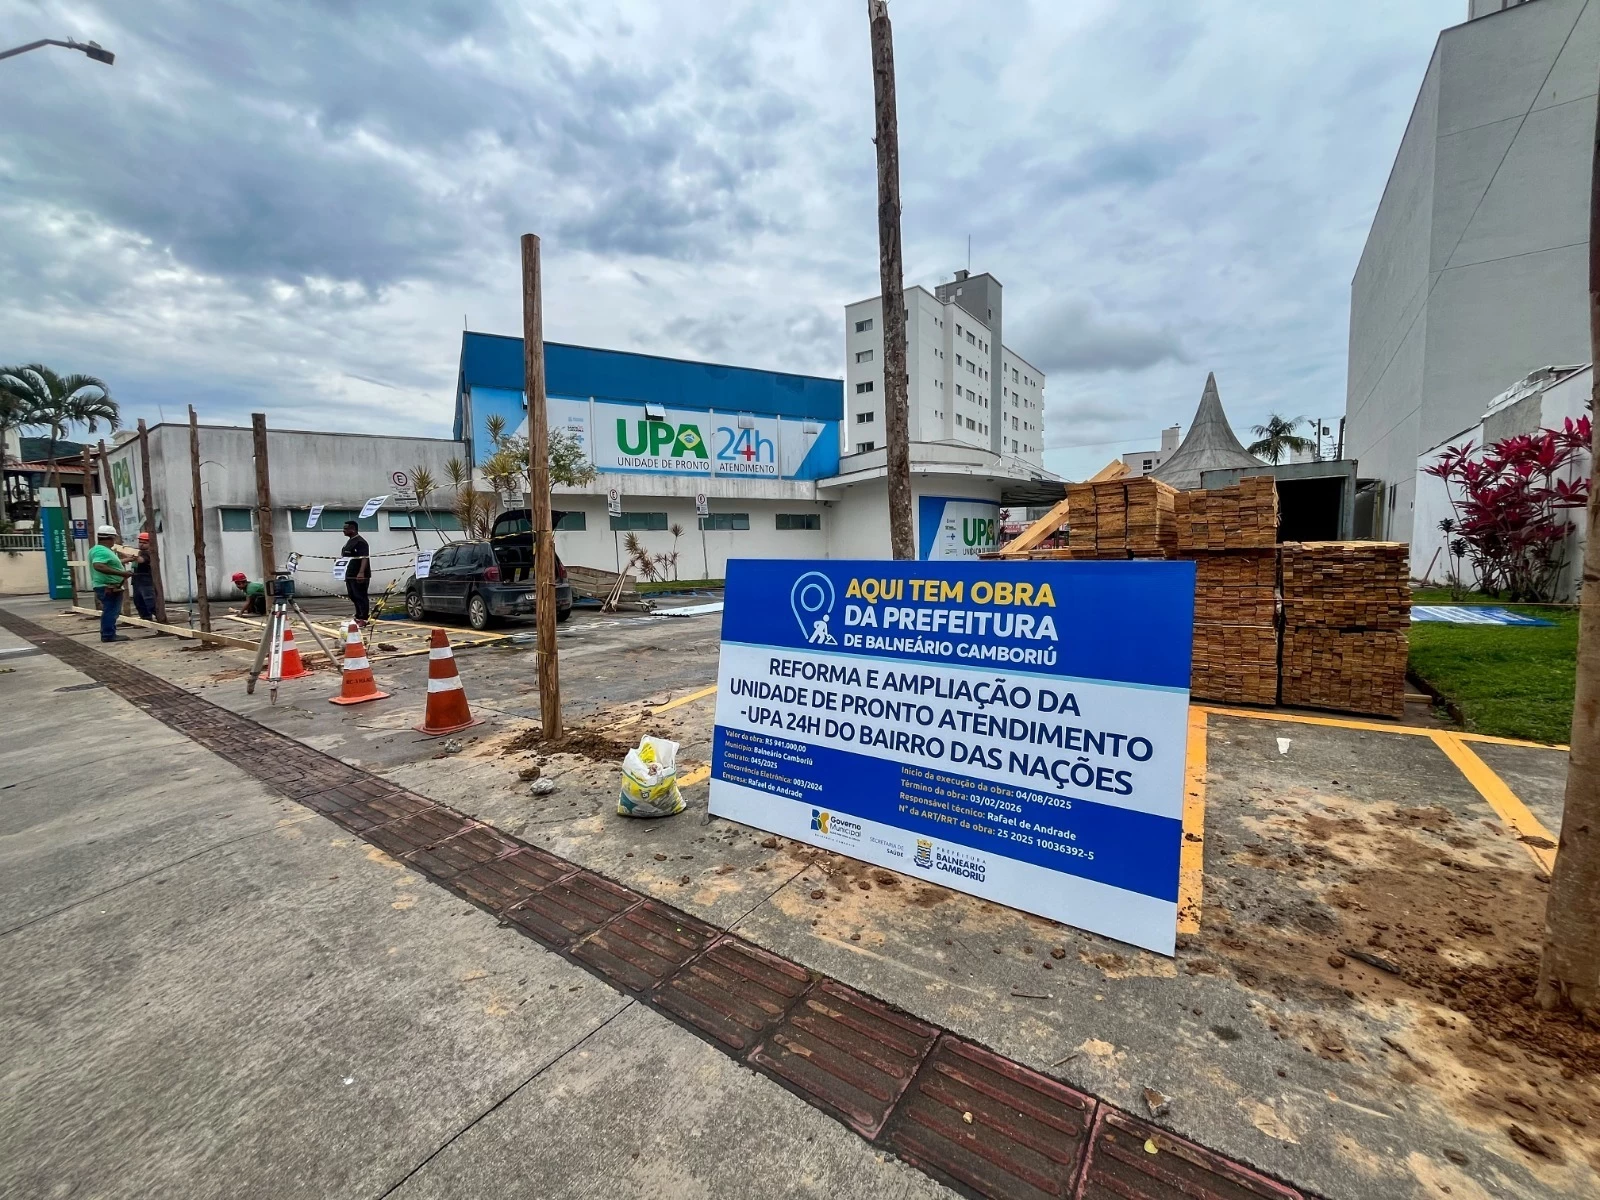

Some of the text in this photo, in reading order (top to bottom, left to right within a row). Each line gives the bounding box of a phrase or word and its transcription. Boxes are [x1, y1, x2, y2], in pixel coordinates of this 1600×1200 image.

[616, 418, 774, 463] UPA 24h
[618, 457, 774, 474] UNIDADE DE PRONTO ATENDIMENTO
[963, 518, 995, 546] UPA
[845, 578, 1056, 607] AQUI TEM OBRA
[844, 604, 1059, 641] DA PREFEITURA
[844, 634, 1057, 666] DE BALNEÁRIO CAMBORIÚ
[770, 658, 1081, 716] REFORMA E AMPLIAÇÃO DA
[730, 678, 1153, 761] UNIDADE DE PRONTO ATENDIMENTO
[724, 751, 778, 768] Contrato: 045/2025
[740, 705, 1133, 795] -UPA 24H DO BAIRRO DAS NAÇÕES
[754, 746, 782, 758] Balneário
[783, 753, 813, 766] Camboriú
[774, 740, 806, 753] 941.000,00
[722, 772, 748, 784] Empresa:
[748, 778, 766, 789] Rafael
[776, 786, 802, 798] Andrade
[723, 761, 823, 791] Concorrência Eletrônica: 003/2024
[901, 779, 1022, 812] Término da obra: 03/02/2026
[924, 771, 934, 780] da
[936, 775, 975, 788] execução
[977, 782, 988, 791] da
[990, 786, 1014, 797] obra:
[1016, 790, 1072, 810] 04/08/2025
[830, 816, 861, 830] Governo
[830, 823, 861, 837] Municipal
[900, 792, 1076, 840] Responsável técnico: Rafael de Andrade
[869, 836, 897, 850] SECRETARIA
[910, 807, 919, 815] da
[921, 810, 958, 825] ART/RRT
[960, 820, 970, 828] da
[972, 824, 995, 835] obra:
[997, 829, 1008, 838] 25
[1010, 832, 1034, 845] 2025
[1036, 839, 1094, 860] 10036392-5
[887, 848, 904, 857] SAÚDE
[936, 853, 986, 872] BALNEÁRIO
[937, 847, 986, 864] PREFEITURA
